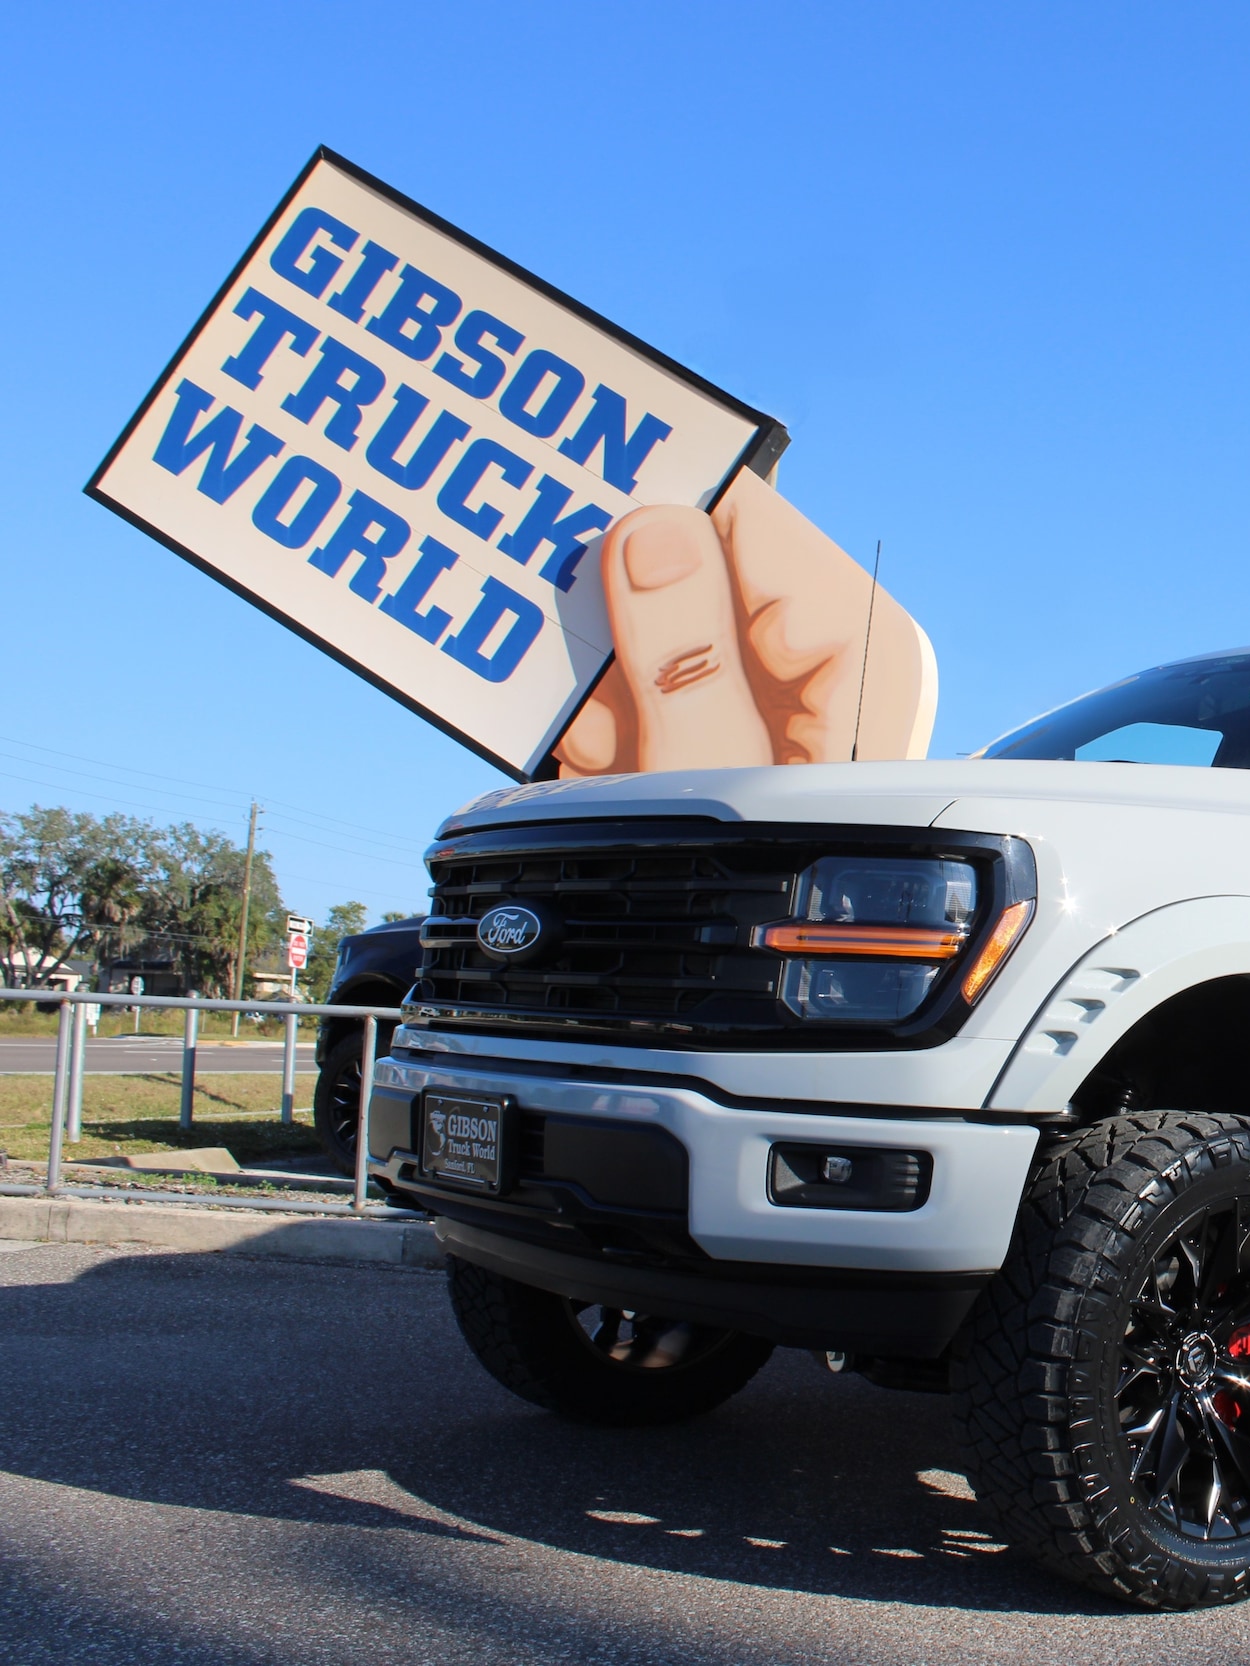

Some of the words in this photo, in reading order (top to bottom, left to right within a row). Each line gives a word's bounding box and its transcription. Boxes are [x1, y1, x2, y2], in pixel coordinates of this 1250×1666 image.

[269, 206, 673, 495] GIBSON
[220, 286, 612, 593] TRUCK
[151, 378, 545, 684] WORLD
[488, 912, 528, 944] Ford
[447, 1114, 497, 1142] GIBSON
[448, 1138, 470, 1157] Truck
[472, 1142, 496, 1160] World
